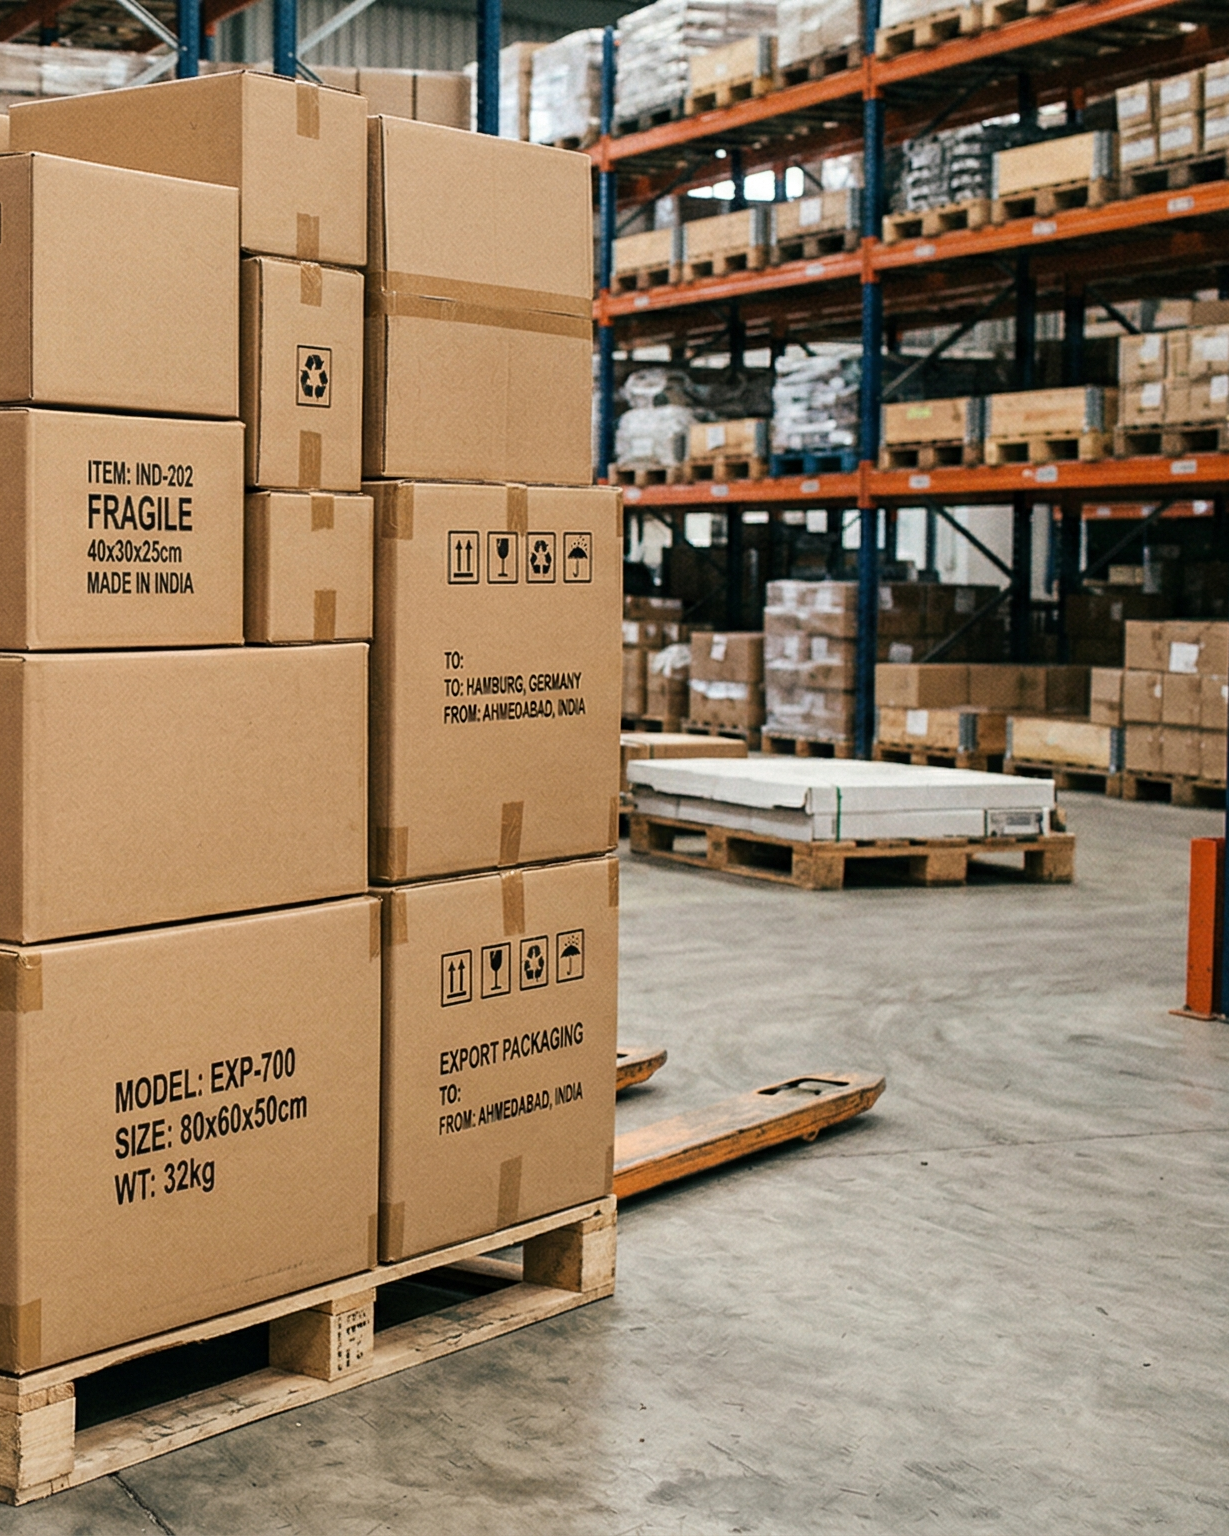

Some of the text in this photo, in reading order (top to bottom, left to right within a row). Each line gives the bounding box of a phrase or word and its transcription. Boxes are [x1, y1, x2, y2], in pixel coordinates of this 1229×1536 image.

[88, 460, 193, 487] ITEM: IND-202
[88, 494, 192, 531] FRAGILE
[88, 539, 182, 563] 40x30x25cm
[88, 572, 194, 594] MADE IN INDIA
[444, 651, 463, 669] TO:
[444, 672, 581, 697] TO: HAMBURG, GERMANY
[444, 704, 480, 724] FROM:
[558, 698, 585, 716] INDIA
[440, 1022, 583, 1075] EXPORT PACKAGING
[116, 1047, 295, 1113] MODEL: EXP-700
[439, 1084, 461, 1105] TO:
[439, 1082, 583, 1135] FROM: AHMEDABAD, INDIA
[115, 1095, 307, 1159] SIZE: 80x60x50cm
[115, 1158, 214, 1205] WT: 32kg
